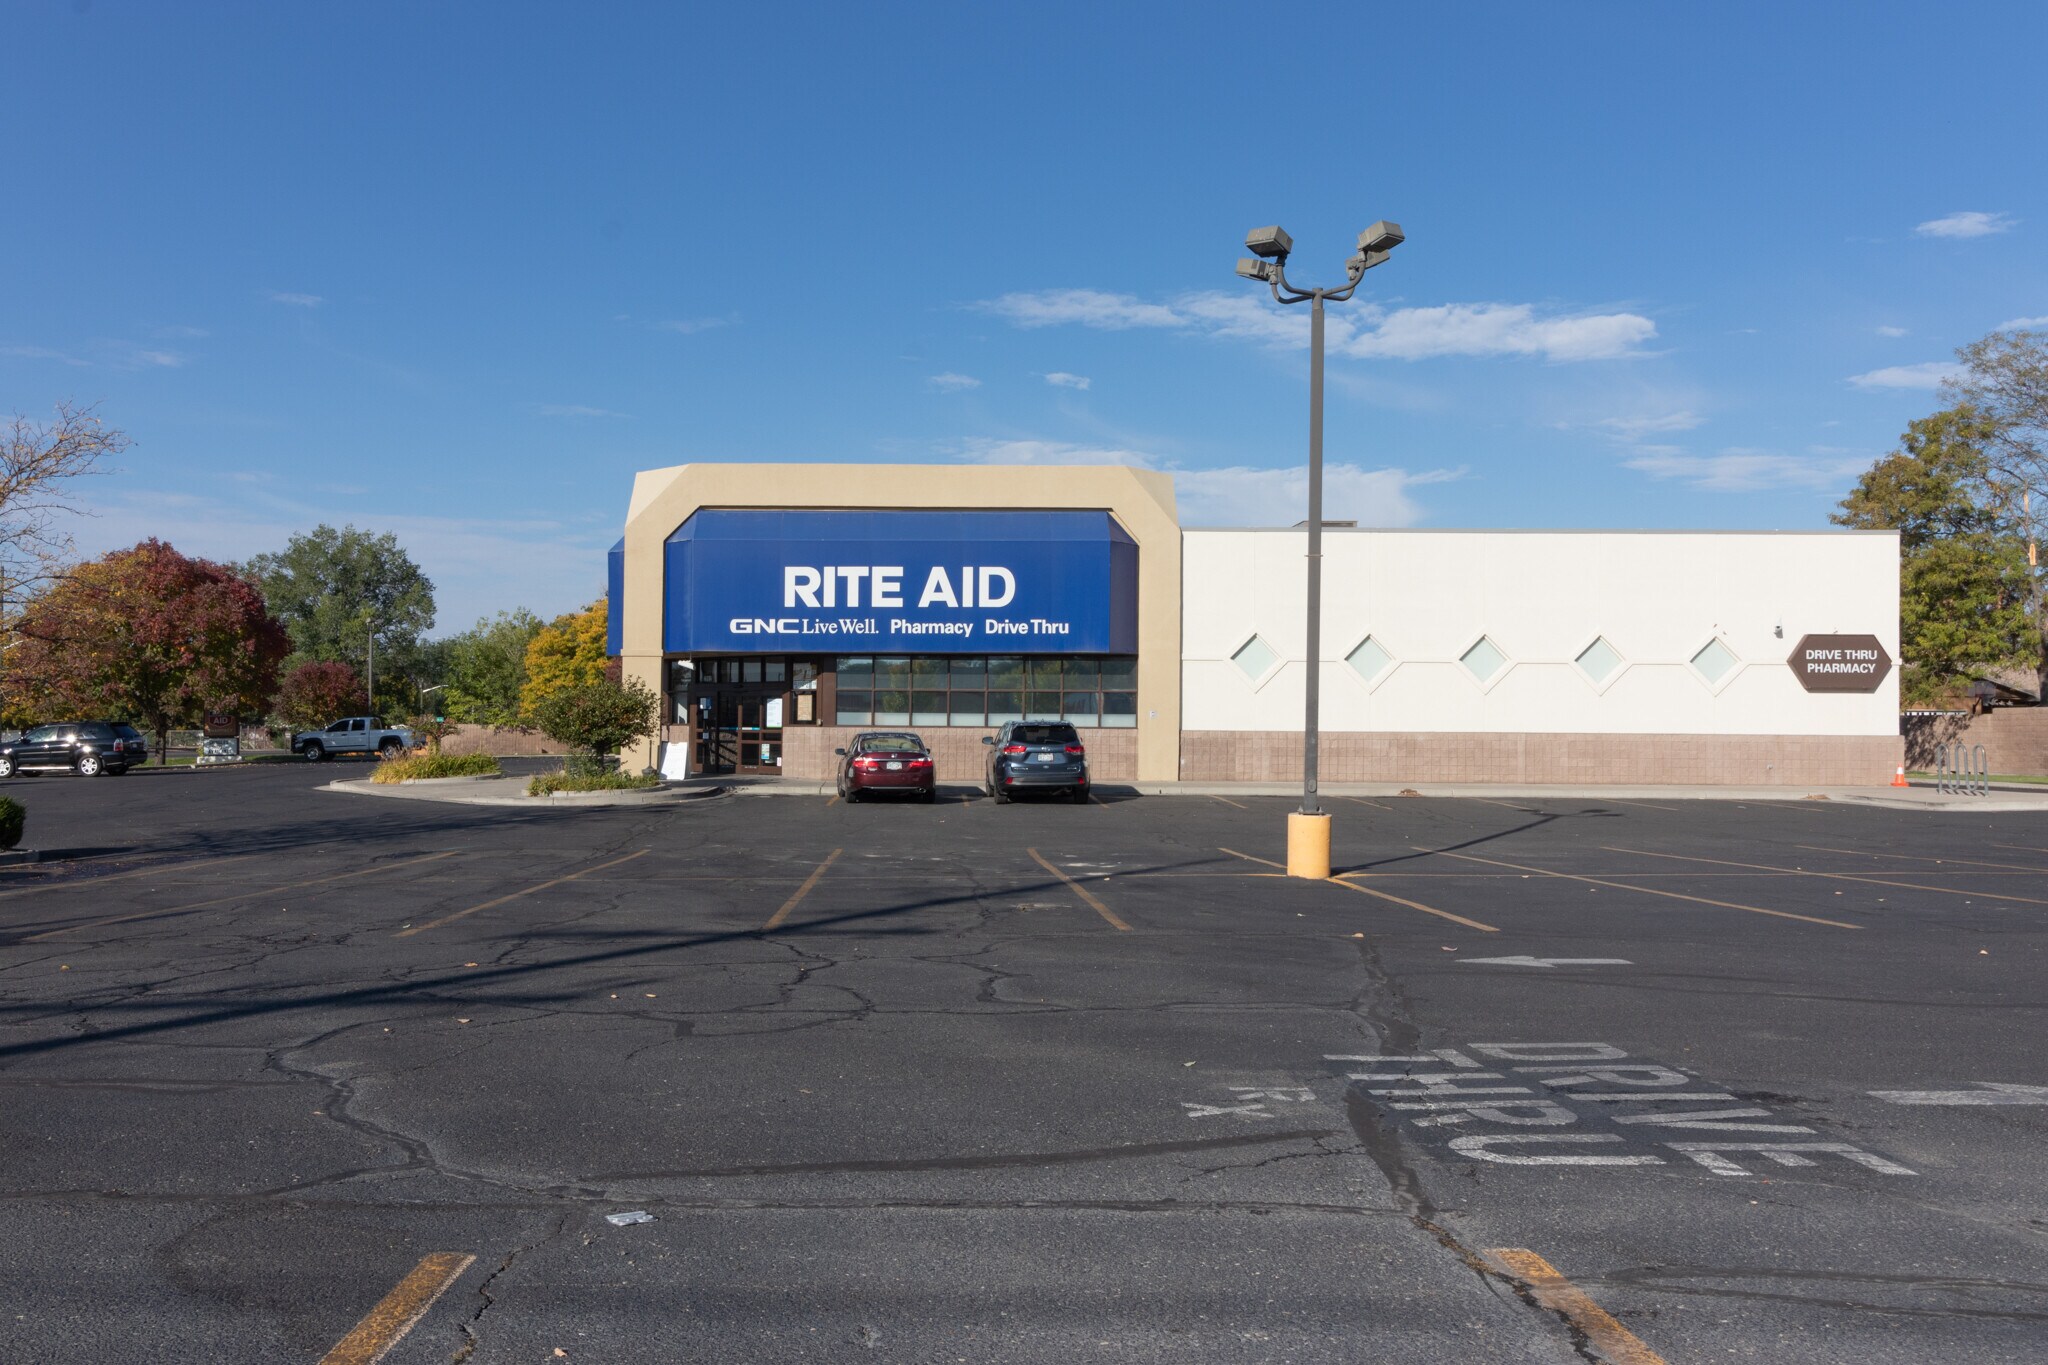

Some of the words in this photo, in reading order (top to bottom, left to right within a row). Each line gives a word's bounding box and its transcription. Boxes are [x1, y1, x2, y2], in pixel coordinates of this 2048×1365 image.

[784, 566, 904, 607] RITE
[917, 566, 1016, 607] AID
[729, 618, 800, 634] GNC
[801, 617, 839, 635] Live
[890, 618, 975, 638] Pharmacy
[984, 618, 1029, 635] Drive
[1029, 618, 1070, 635] Thru
[1806, 650, 1841, 660] DRIVE
[1845, 650, 1877, 660] THRU
[1807, 663, 1875, 673] PHARMACY
[1321, 1048, 1668, 1166] THRU
[1466, 1042, 1919, 1175] DRIVE
